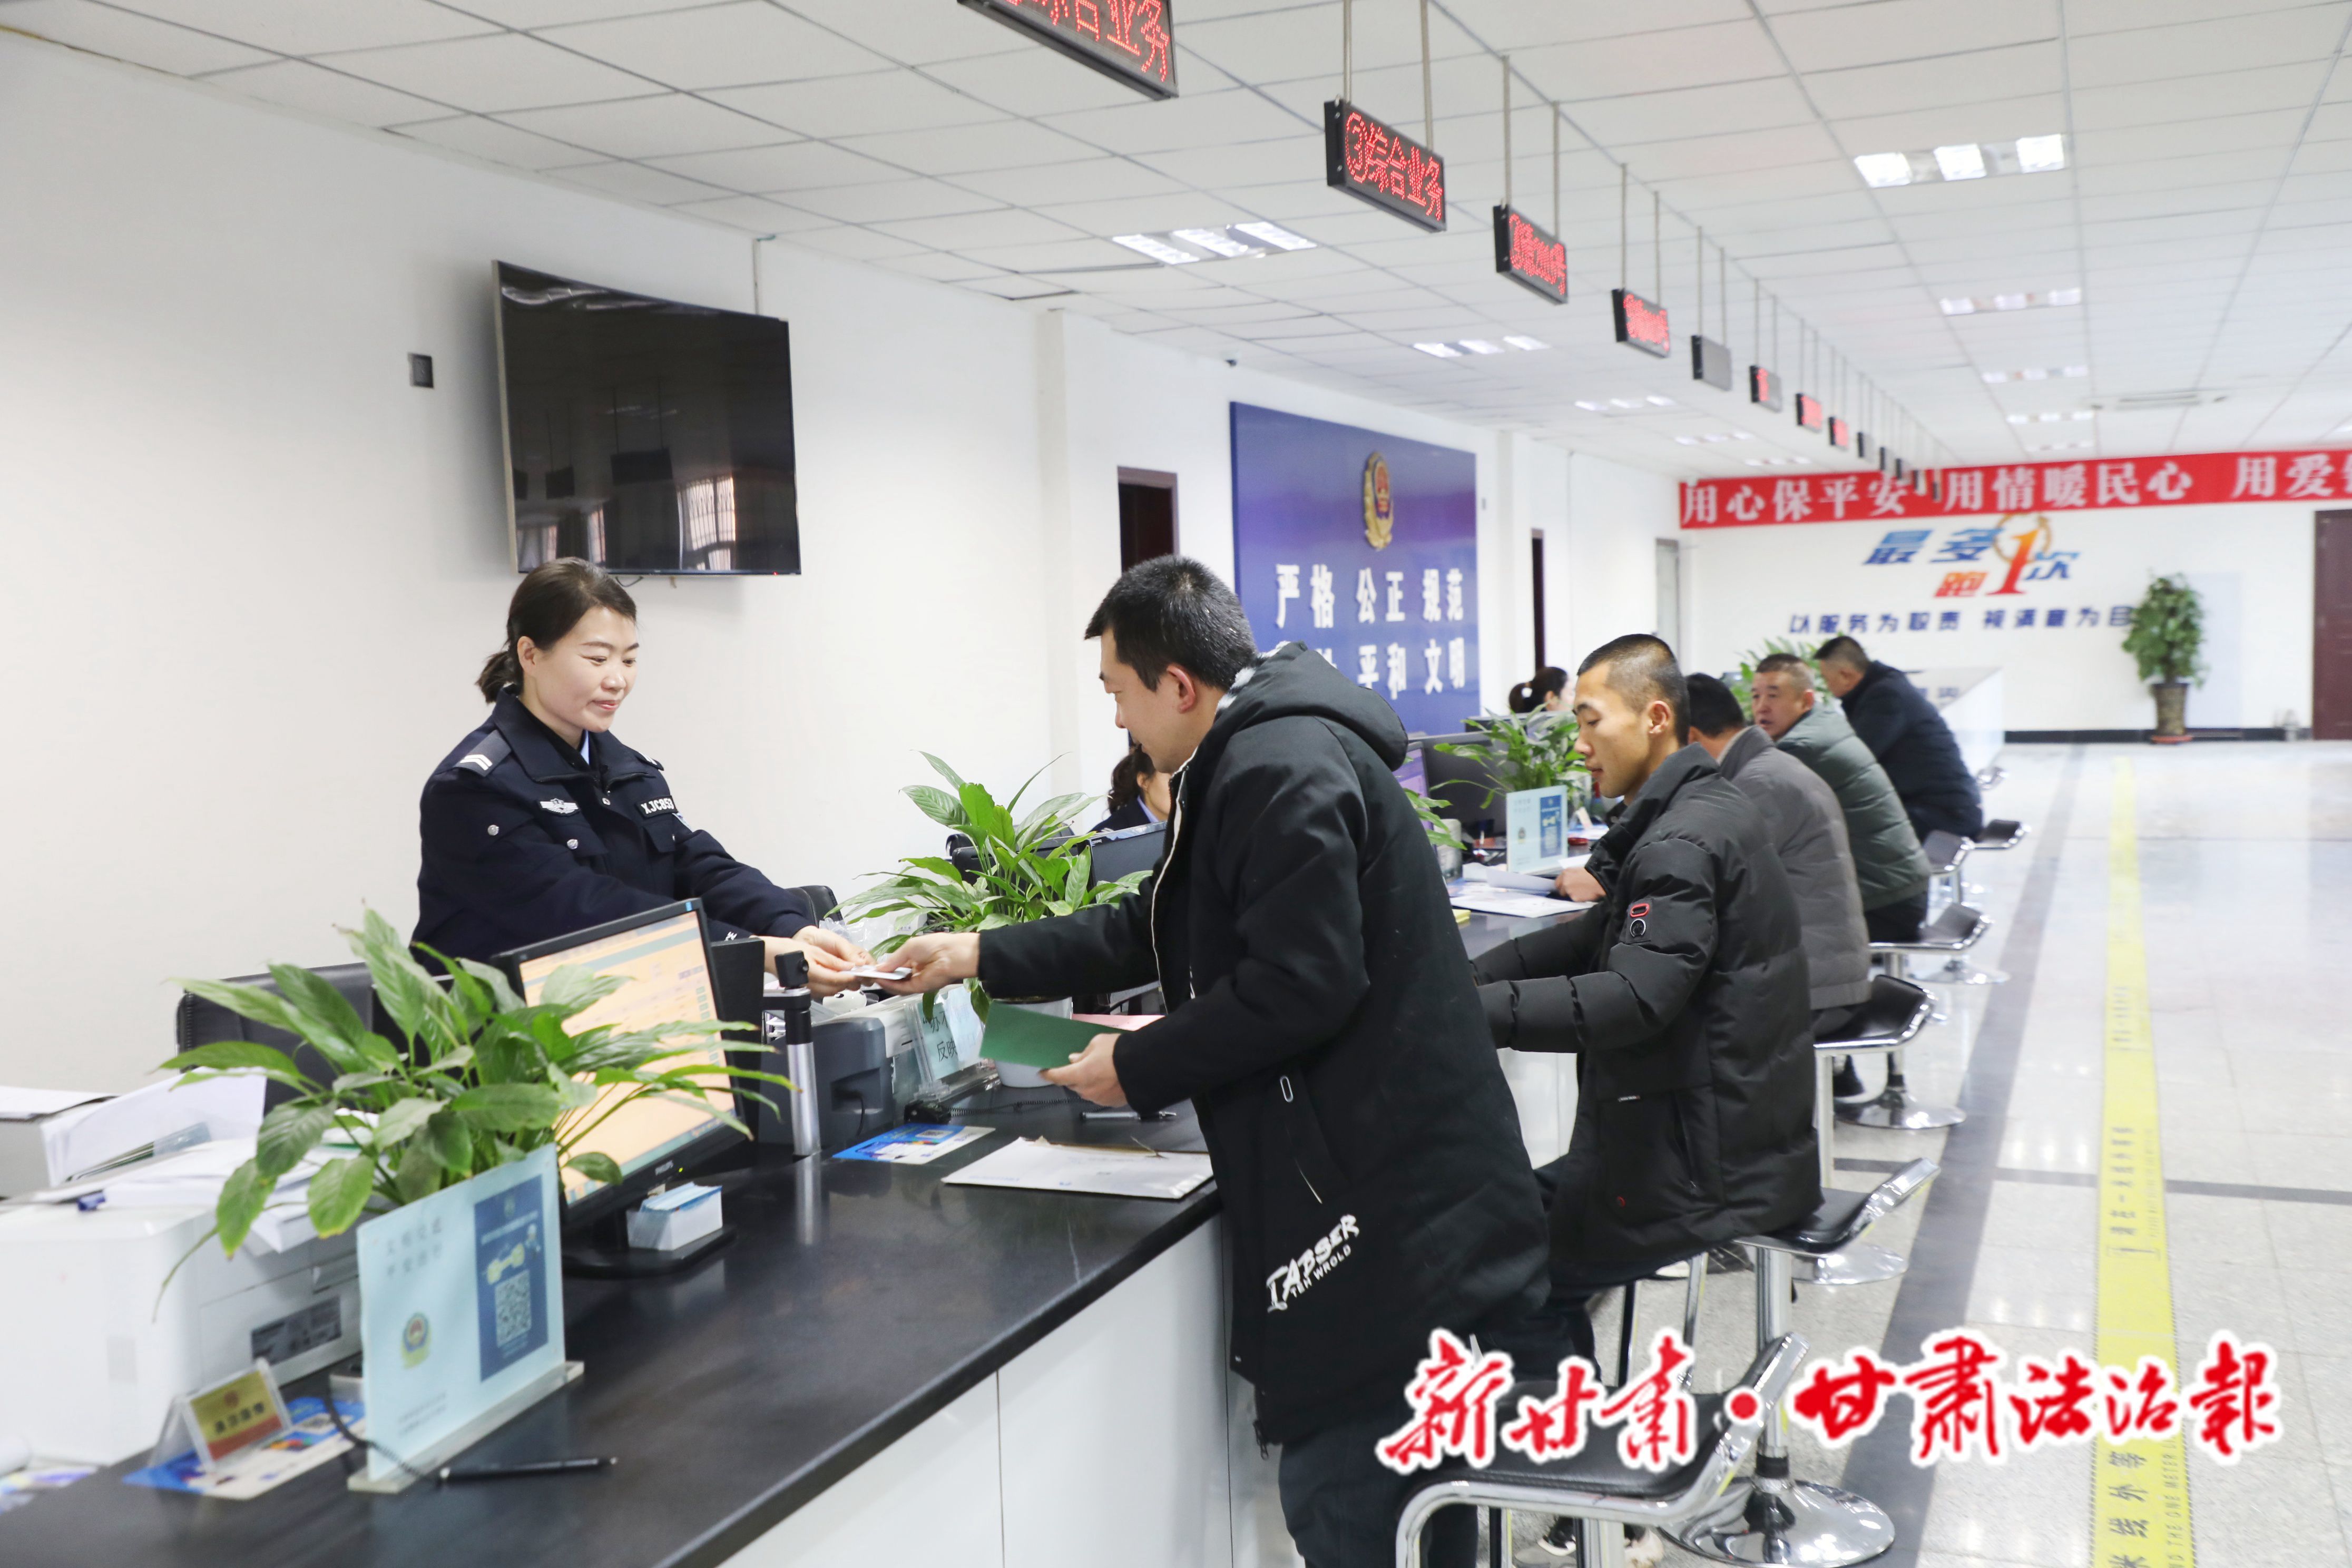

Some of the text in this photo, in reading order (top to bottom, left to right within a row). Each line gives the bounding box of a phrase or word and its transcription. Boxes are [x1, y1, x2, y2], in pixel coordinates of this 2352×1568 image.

[1682, 453, 2352, 524] 用心保平安 用情暖民心 用爱
[1275, 564, 1335, 629] 严格
[1356, 567, 1406, 624] 公正
[1357, 636, 1466, 700] 平和 文明
[640, 798, 674, 815] XJC853
